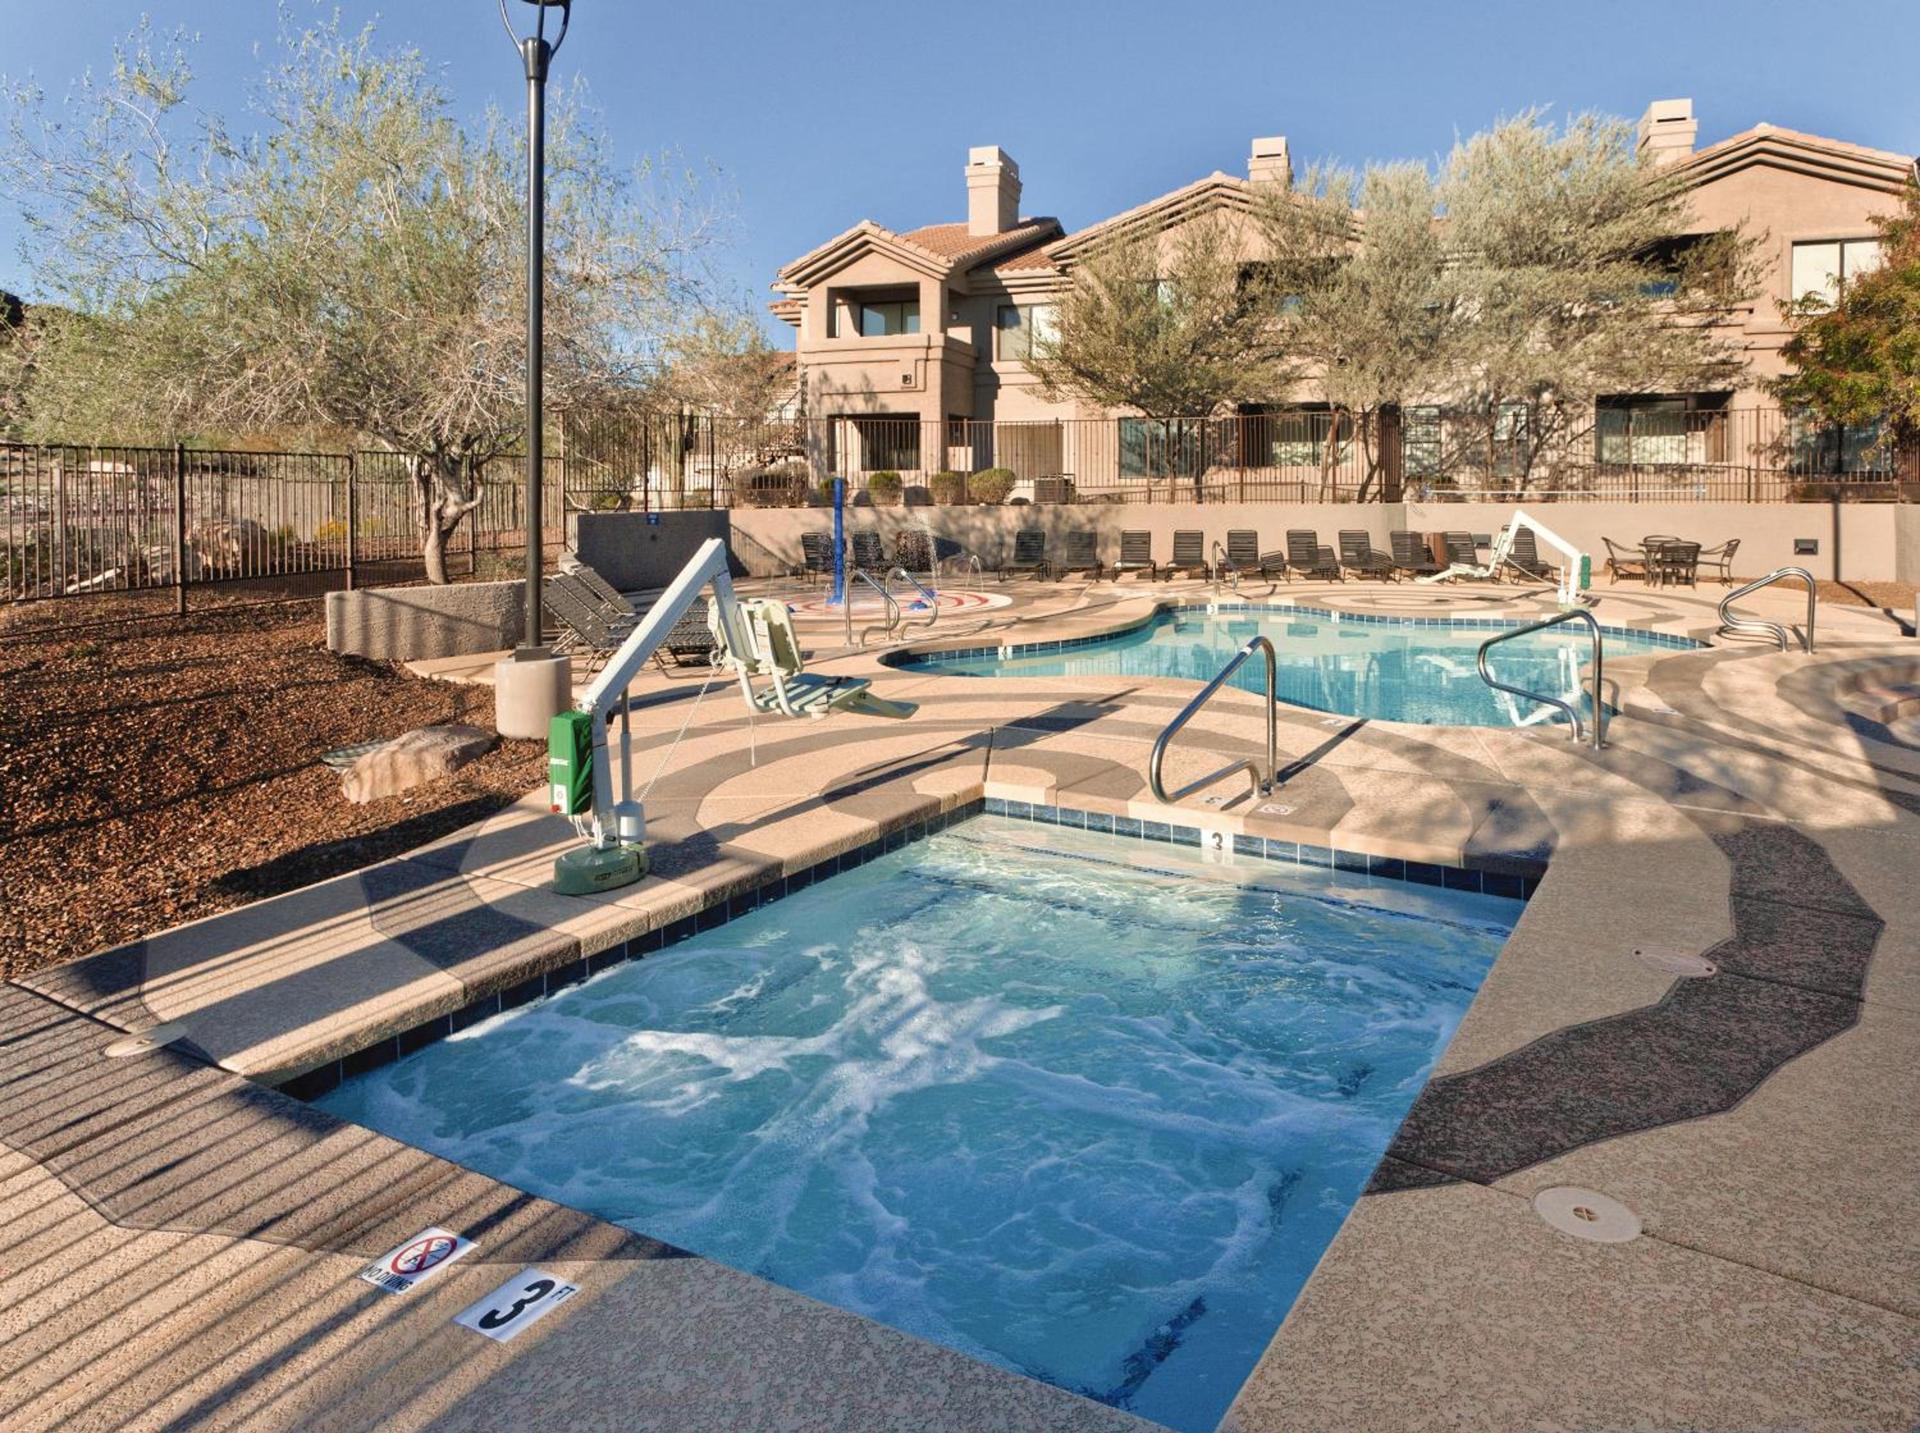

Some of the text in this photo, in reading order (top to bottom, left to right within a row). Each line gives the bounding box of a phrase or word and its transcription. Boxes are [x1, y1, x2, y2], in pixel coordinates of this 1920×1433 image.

[1212, 832, 1223, 851] 3
[363, 1264, 414, 1291] NO DIVING
[478, 1279, 576, 1330] 3 FT
